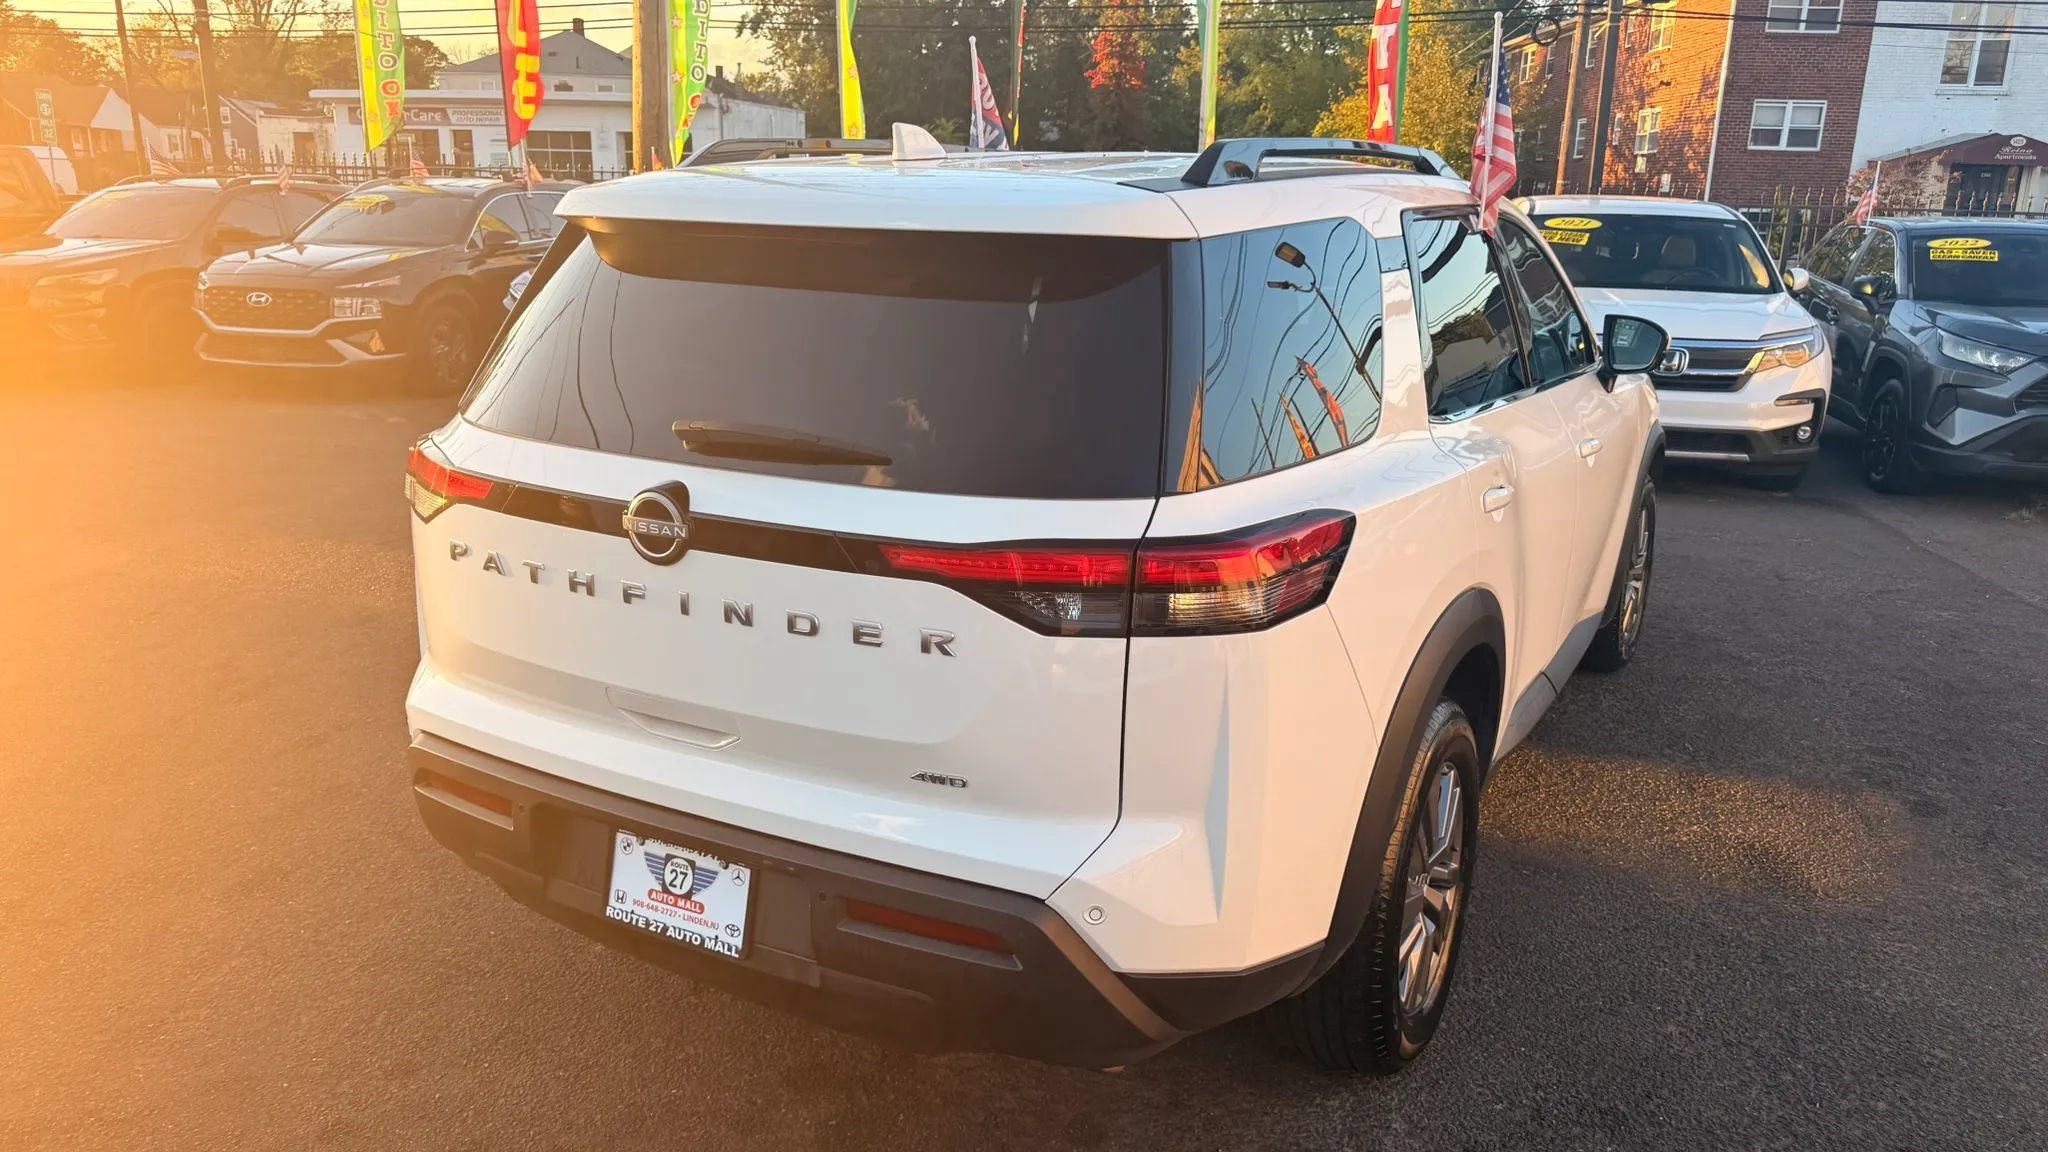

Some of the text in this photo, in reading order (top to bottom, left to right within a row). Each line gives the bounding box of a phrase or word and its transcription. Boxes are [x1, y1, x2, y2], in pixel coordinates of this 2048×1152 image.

[380, 79, 401, 119] OK
[1554, 219, 1592, 227] 2021
[623, 517, 687, 538] NISSAN
[449, 538, 957, 657] PATHFINDER
[910, 770, 968, 789] 4WD
[670, 860, 690, 872] ROUTE
[668, 869, 689, 890] 27
[633, 898, 678, 918] 908-648-2727
[650, 890, 702, 913] AUTO MALL
[606, 905, 740, 958] ROUTE 27 AUTO MALL
